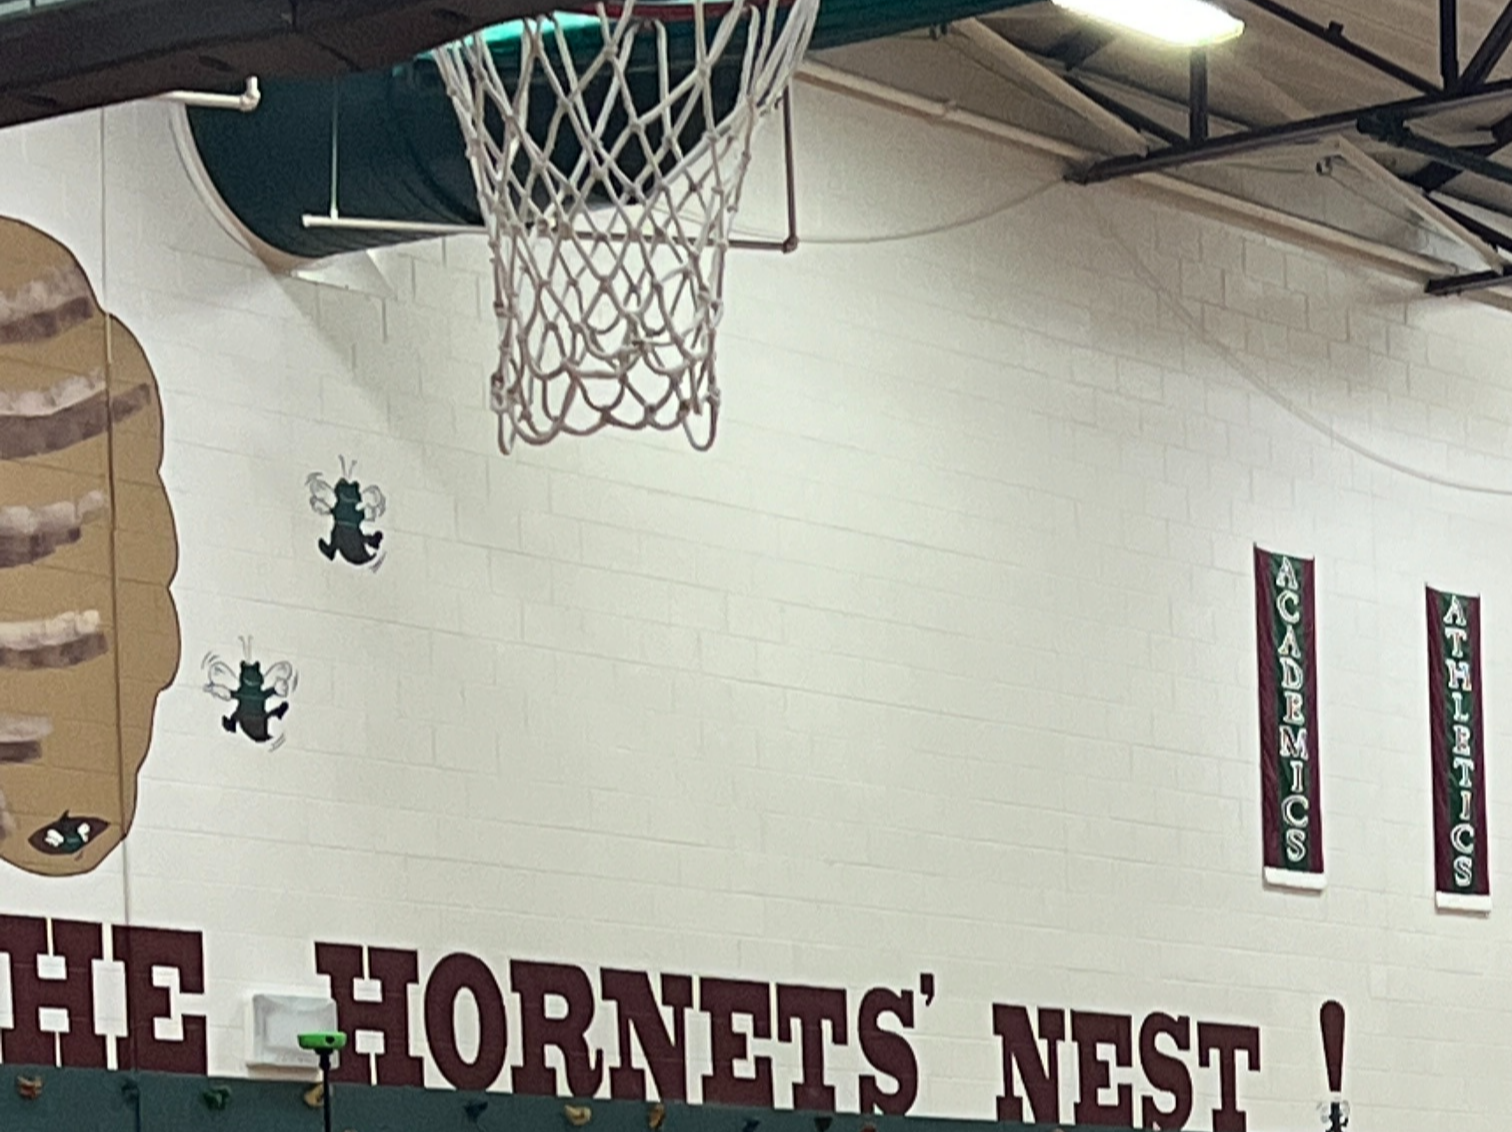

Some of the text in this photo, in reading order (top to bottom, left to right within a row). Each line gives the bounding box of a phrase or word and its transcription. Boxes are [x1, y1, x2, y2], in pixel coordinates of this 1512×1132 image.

[1276, 556, 1308, 862] ACADEMICS
[1443, 594, 1476, 888] ATHLETICS
[314, 941, 935, 1118] HORNETS'
